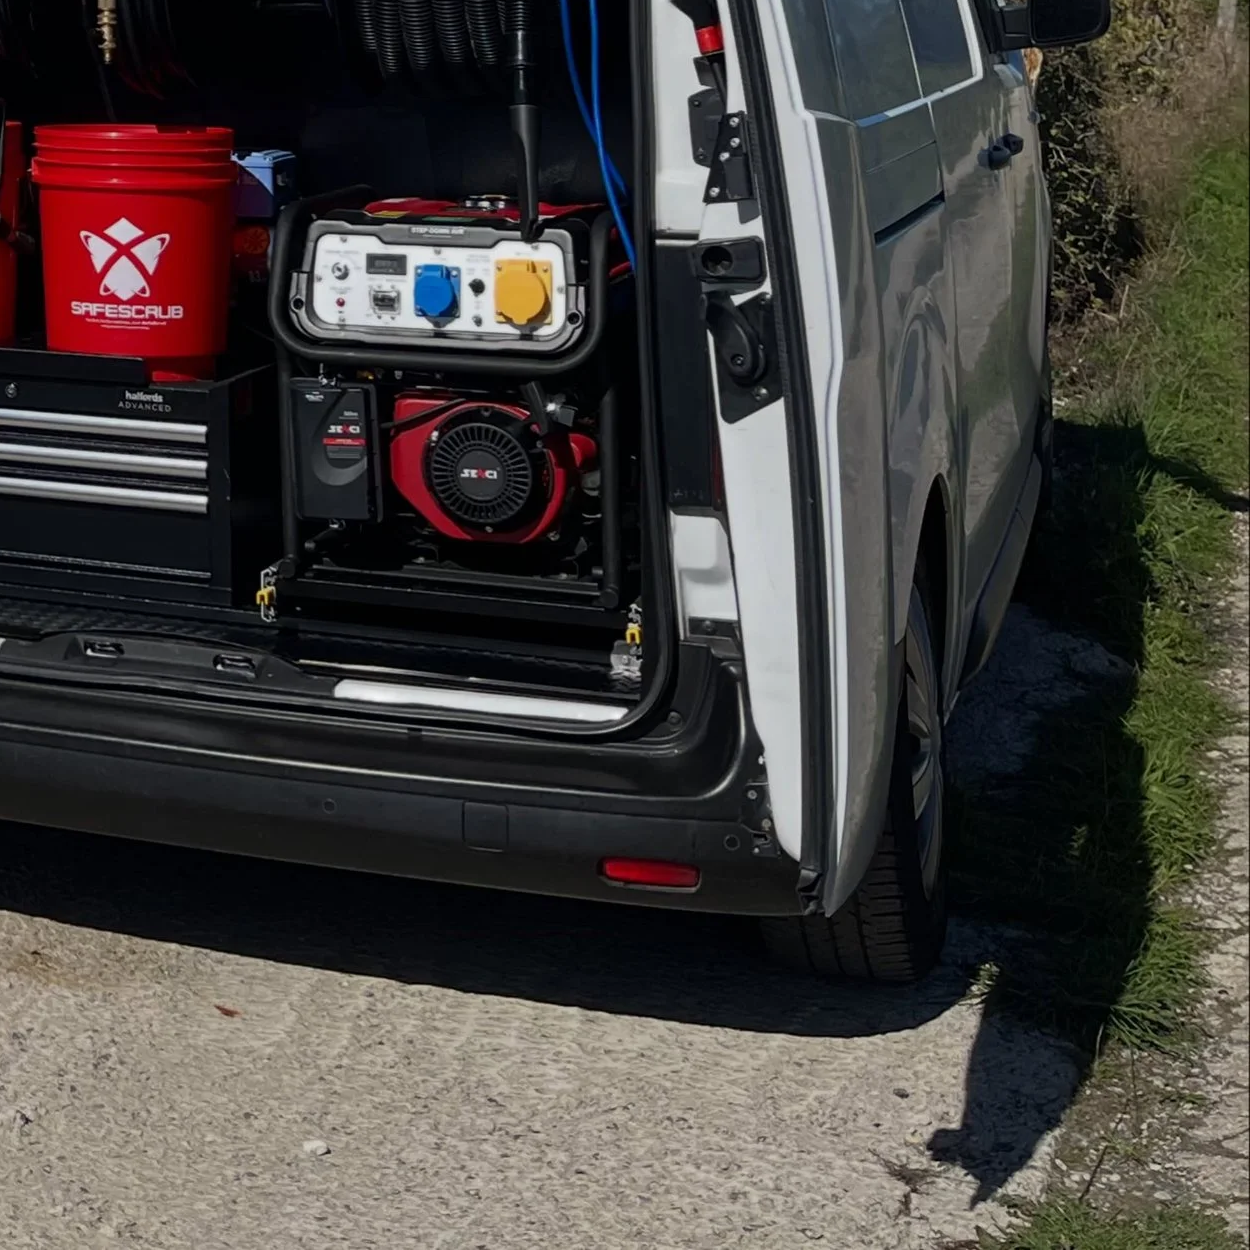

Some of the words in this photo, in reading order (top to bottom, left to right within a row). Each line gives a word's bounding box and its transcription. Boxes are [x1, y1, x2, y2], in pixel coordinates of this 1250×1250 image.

[70, 300, 184, 319] SAFESCRUB
[125, 390, 164, 403] halfords
[117, 400, 172, 413] ADVANCED
